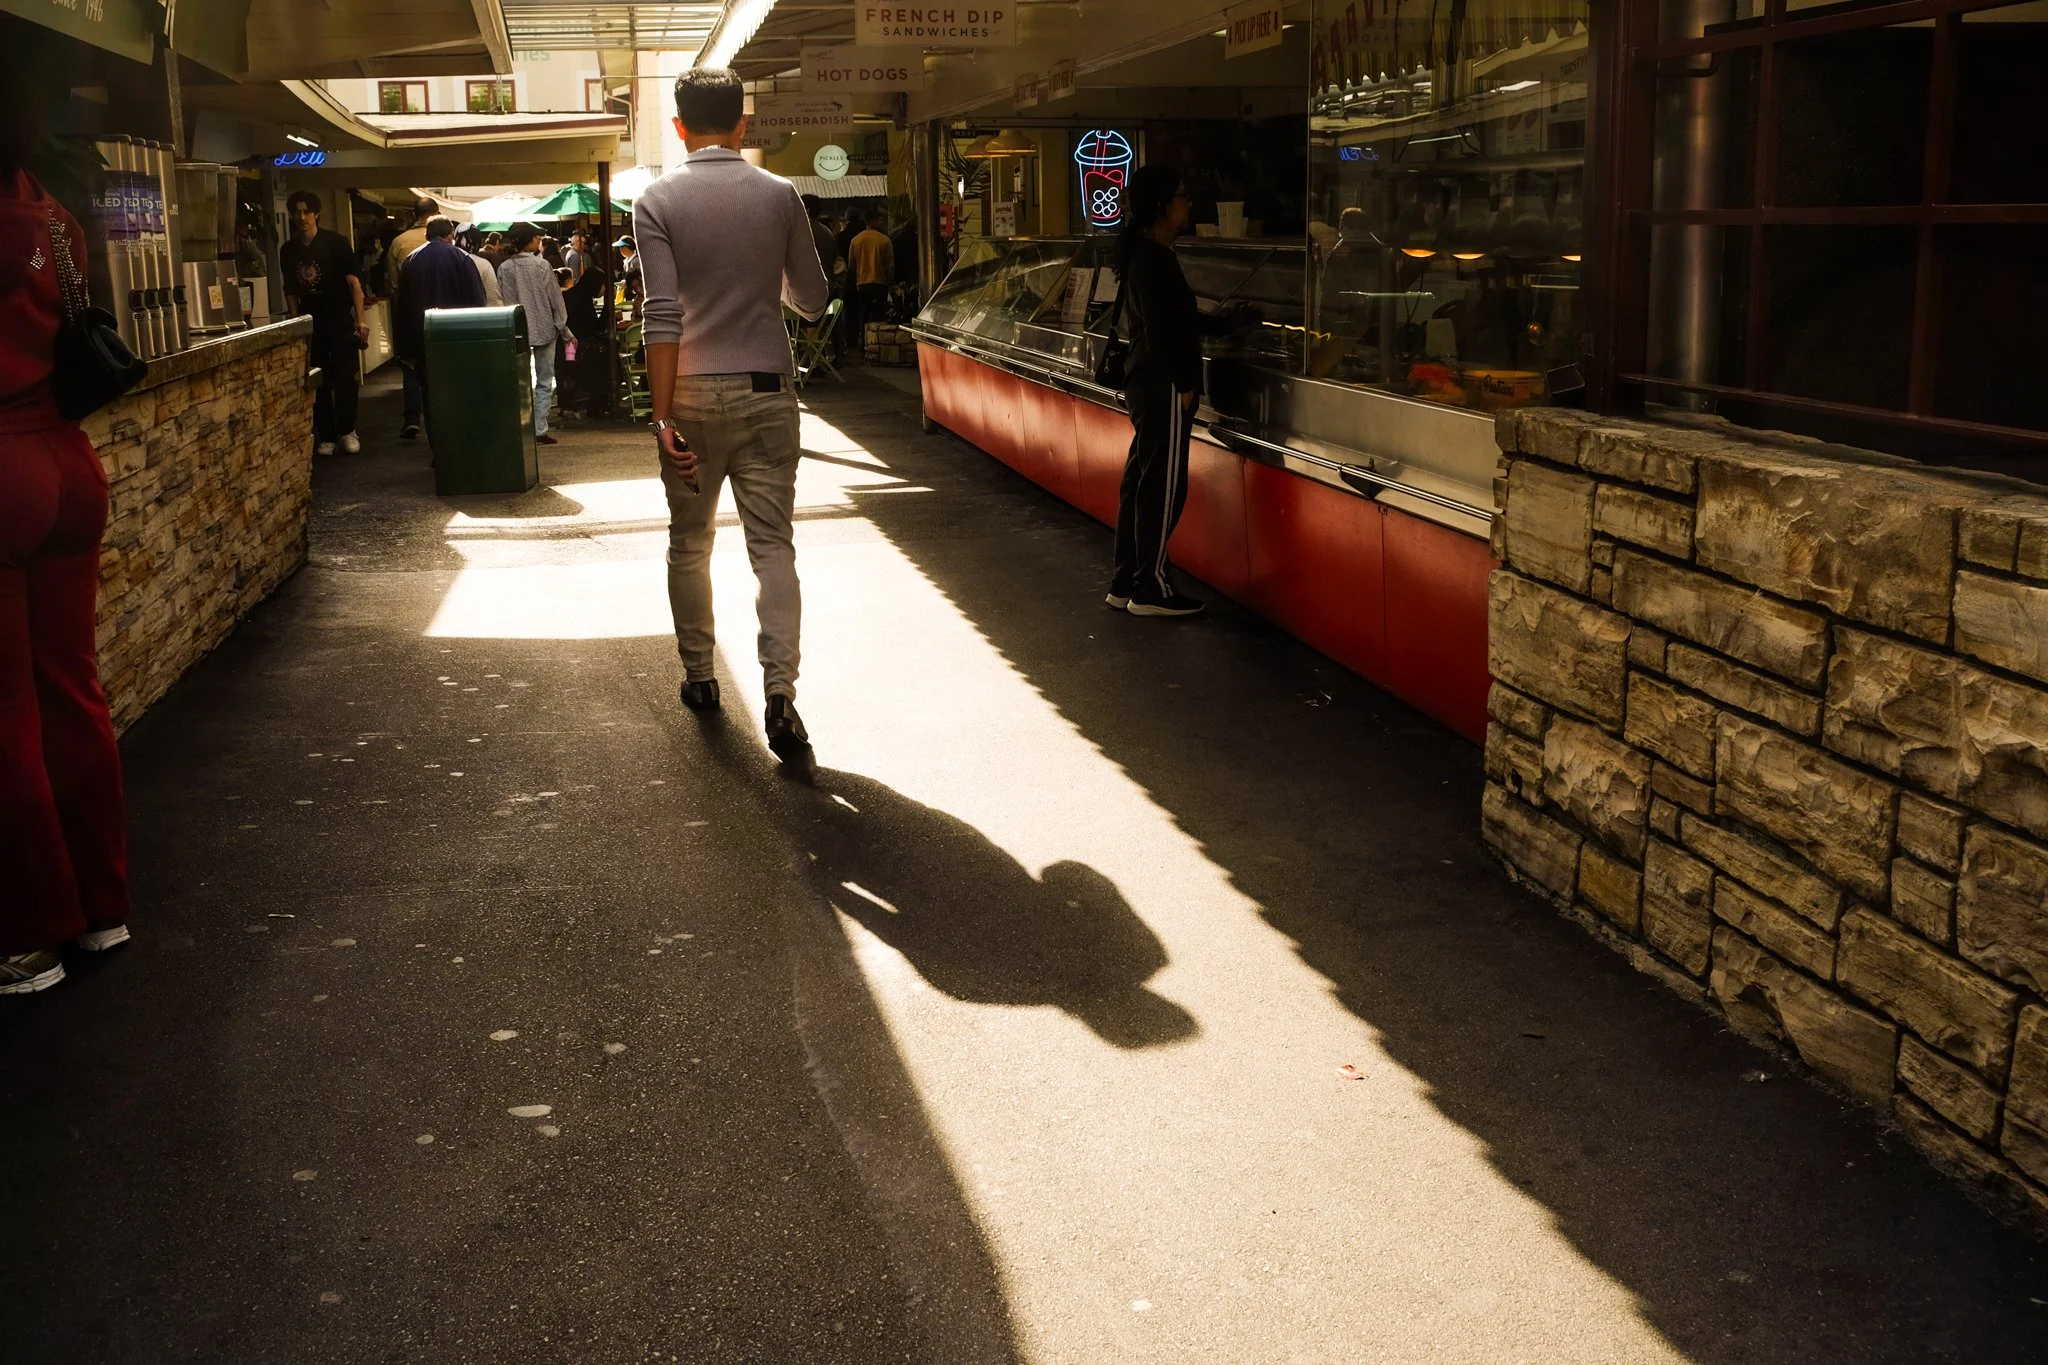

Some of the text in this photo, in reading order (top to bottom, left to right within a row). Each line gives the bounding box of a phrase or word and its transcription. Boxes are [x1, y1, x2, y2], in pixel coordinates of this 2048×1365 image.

[866, 9, 1004, 23] FRENCH DIP
[883, 26, 990, 37] SANDWICHES
[1235, 10, 1271, 45] PICK UP HERE
[817, 68, 908, 82] HOT DOGS
[760, 115, 849, 127] HORSERADISH
[742, 138, 771, 146] CHEN
